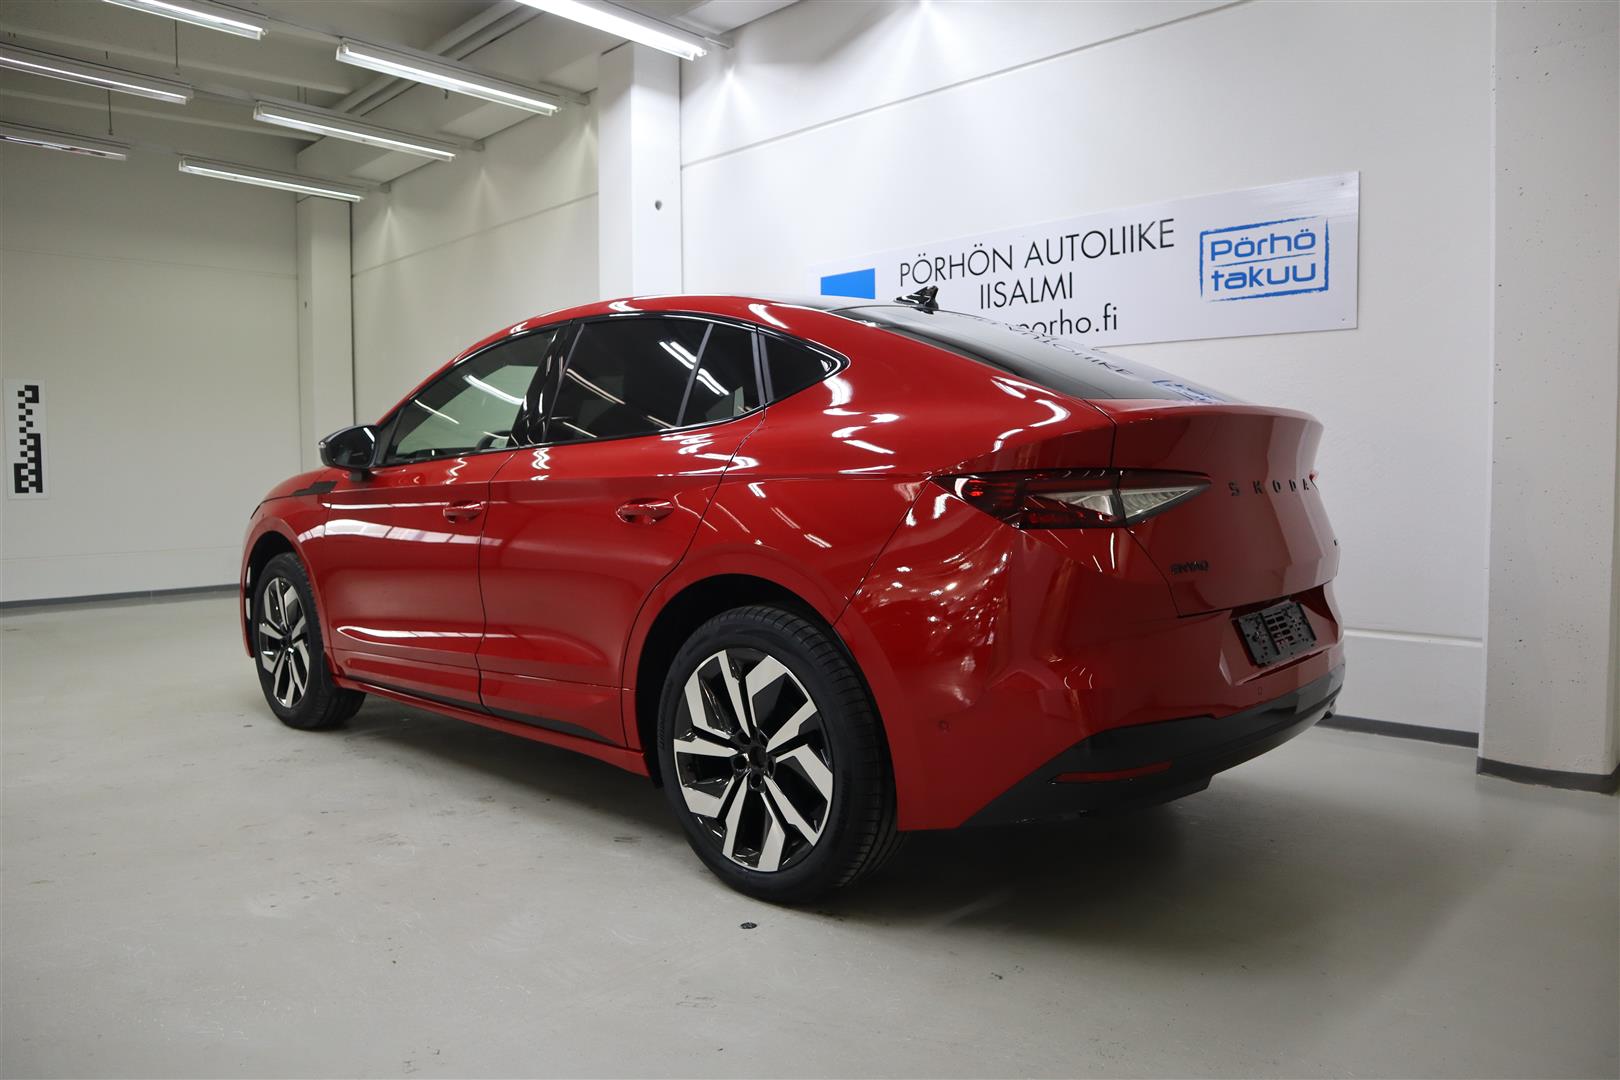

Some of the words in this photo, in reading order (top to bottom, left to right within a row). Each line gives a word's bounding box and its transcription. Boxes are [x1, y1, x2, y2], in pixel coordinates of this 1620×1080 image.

[900, 243, 1013, 287] PÖRHÖN
[1024, 218, 1175, 269] AUTOLIIKE
[1210, 228, 1316, 261] Pörhö
[980, 271, 1073, 310] IISALMI
[1210, 263, 1316, 291] takuu
